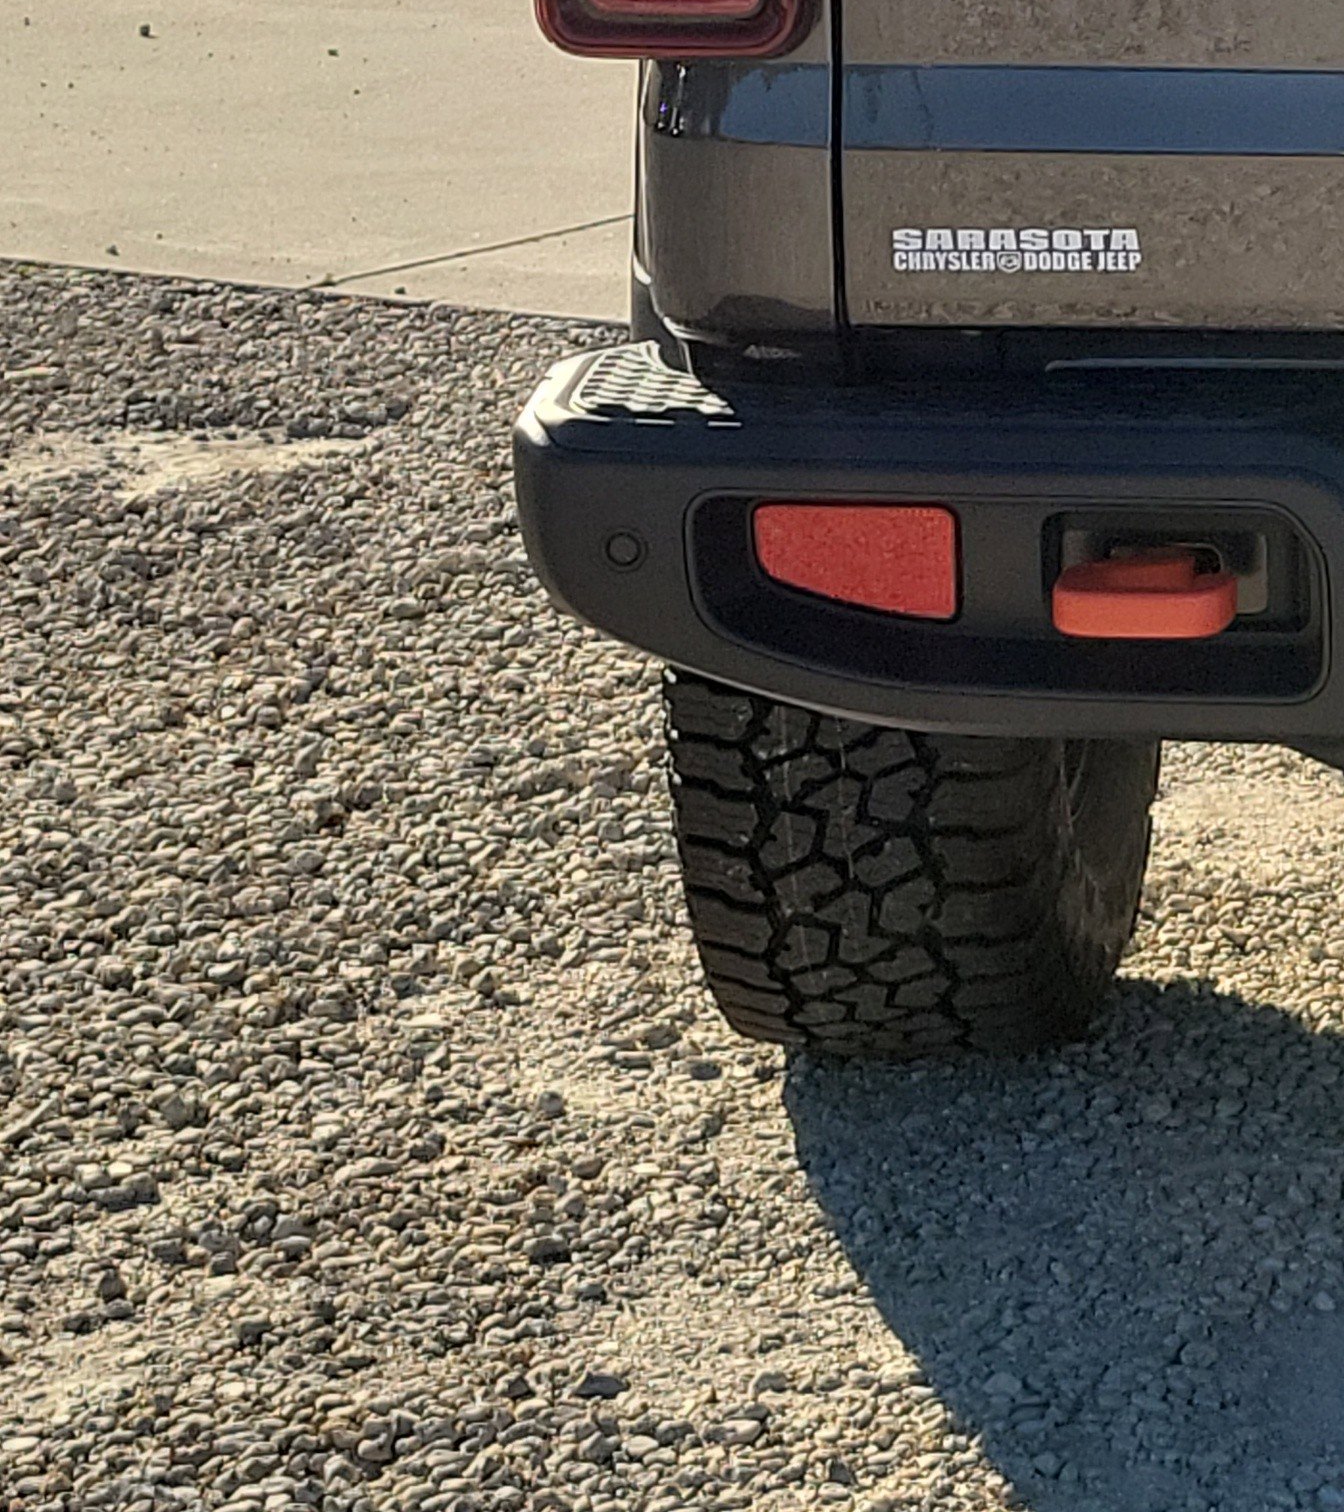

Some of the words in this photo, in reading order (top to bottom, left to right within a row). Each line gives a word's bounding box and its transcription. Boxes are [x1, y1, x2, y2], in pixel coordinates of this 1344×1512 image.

[892, 228, 1140, 251] SARASOTA
[893, 251, 996, 271] CHRYSLER
[1024, 251, 1092, 271] DODGE
[1096, 251, 1142, 271] JEEP
